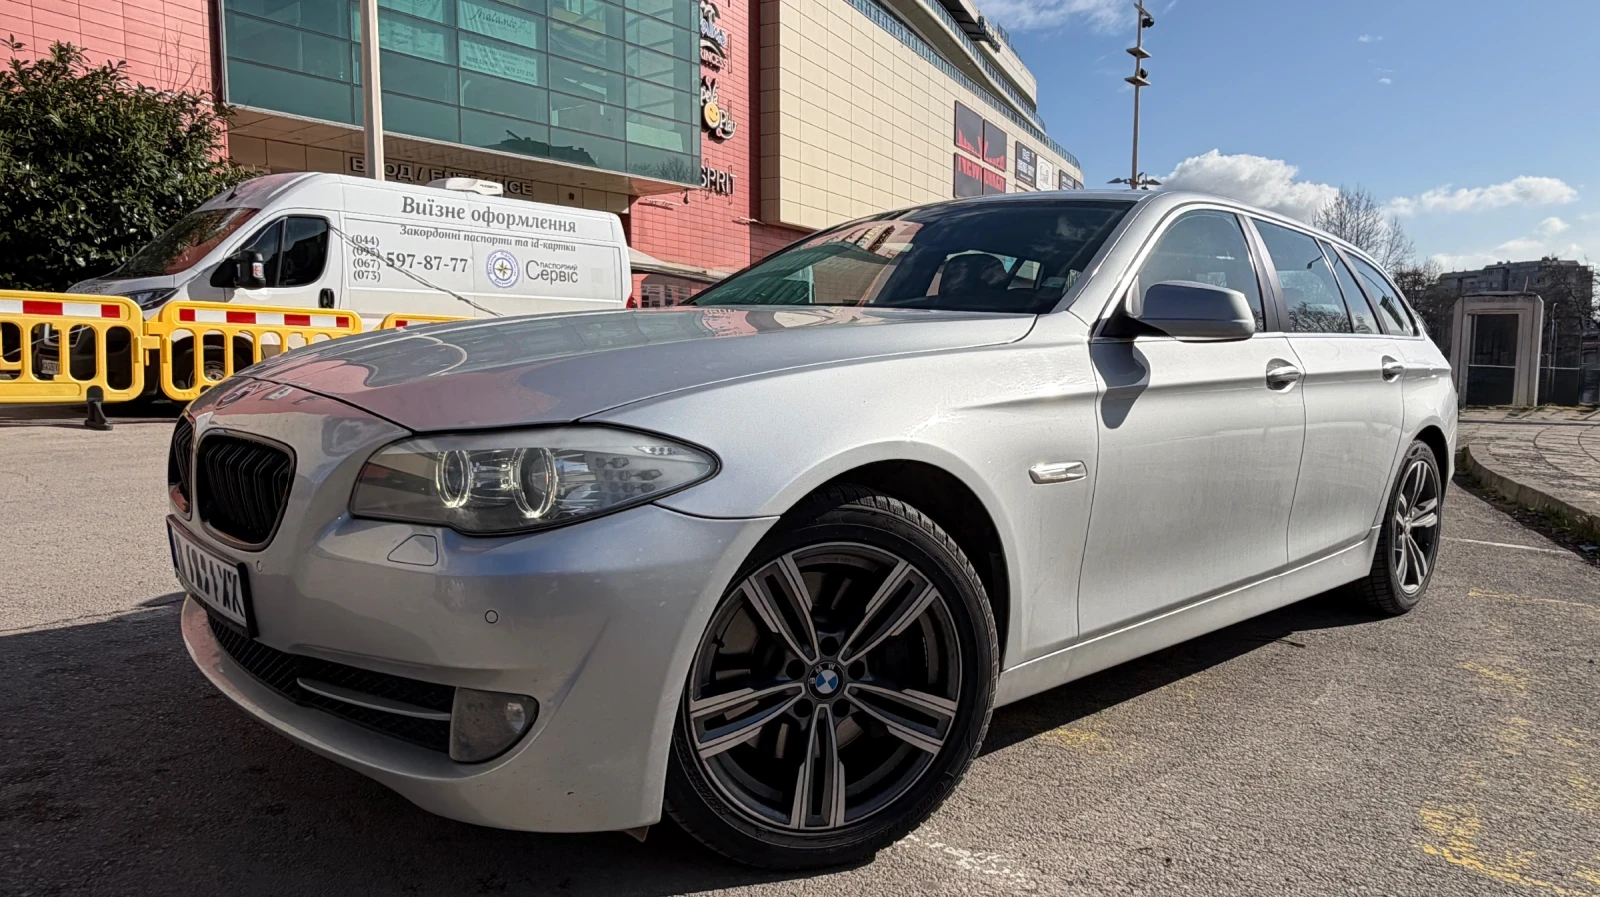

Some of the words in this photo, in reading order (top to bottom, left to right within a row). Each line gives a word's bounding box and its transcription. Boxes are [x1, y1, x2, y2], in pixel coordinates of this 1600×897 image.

[350, 156, 414, 183] ВОД
[401, 195, 466, 220] Виїзне
[471, 206, 577, 233] оформлення
[351, 234, 380, 247] (044)
[400, 224, 461, 241] Закордонні
[463, 233, 513, 247] паспорти
[514, 238, 529, 248] та
[352, 257, 381, 271] (067)
[385, 251, 469, 273] 597-87-77
[353, 269, 382, 283] (073)
[809, 663, 836, 685] BMW
